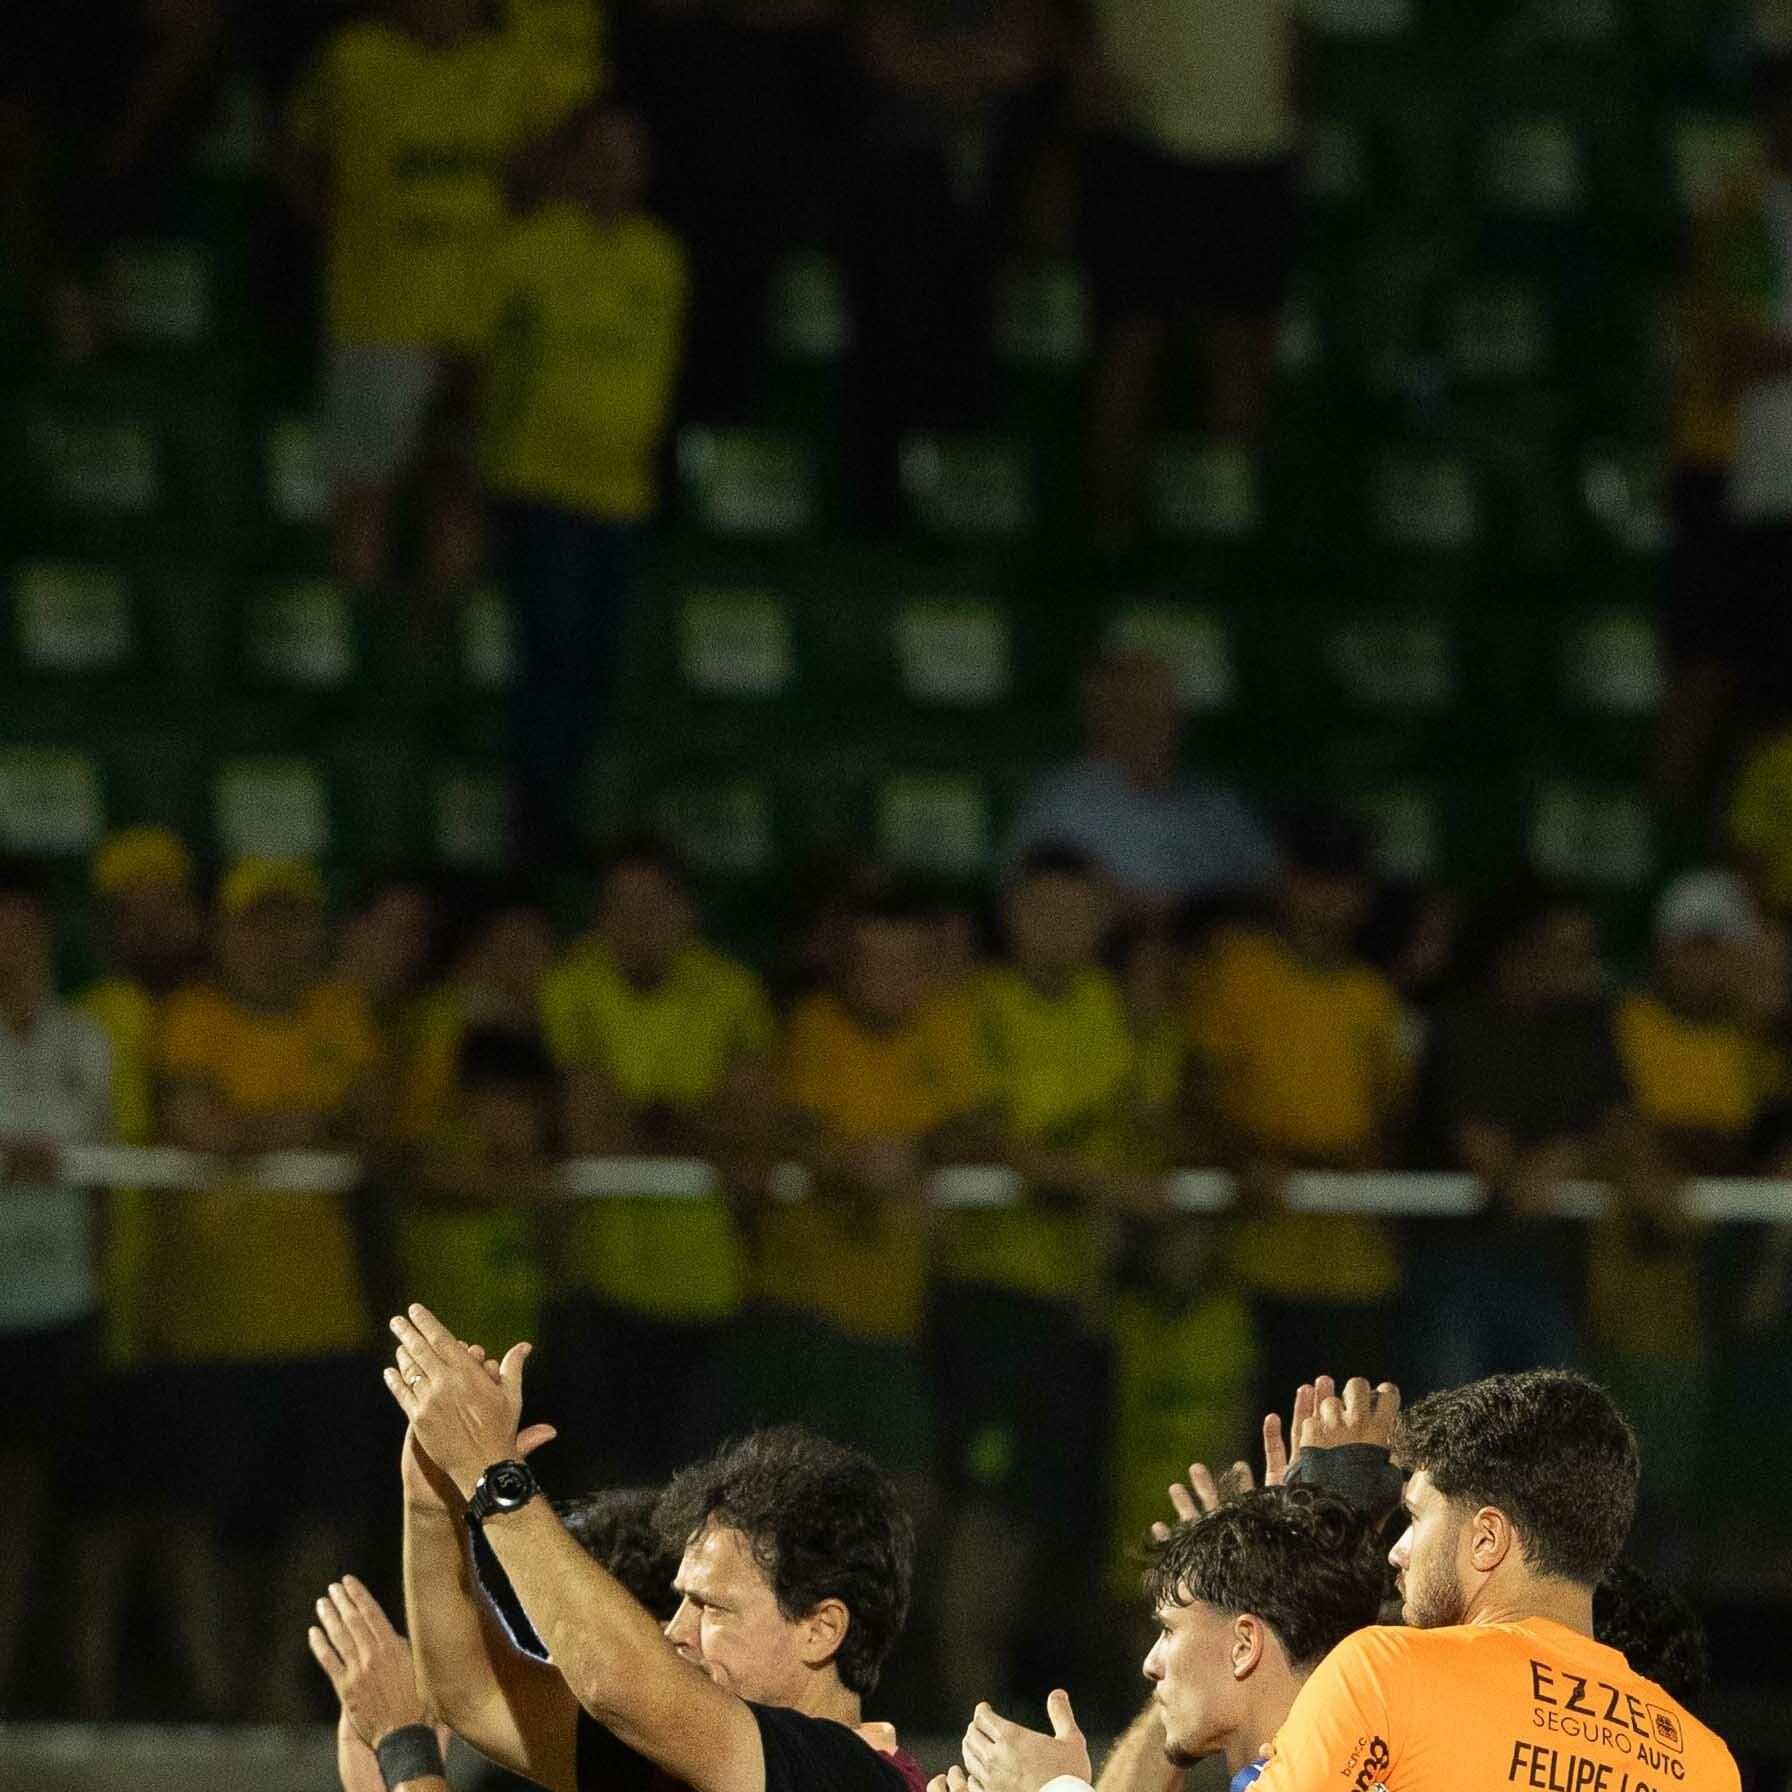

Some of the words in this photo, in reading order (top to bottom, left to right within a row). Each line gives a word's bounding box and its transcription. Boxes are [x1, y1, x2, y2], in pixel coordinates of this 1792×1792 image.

[1530, 1659, 1650, 1739] EZZE
[1532, 1707, 1632, 1754] SEGURO
[1341, 1737, 1368, 1777] banco
[1637, 1743, 1685, 1781] AUTO
